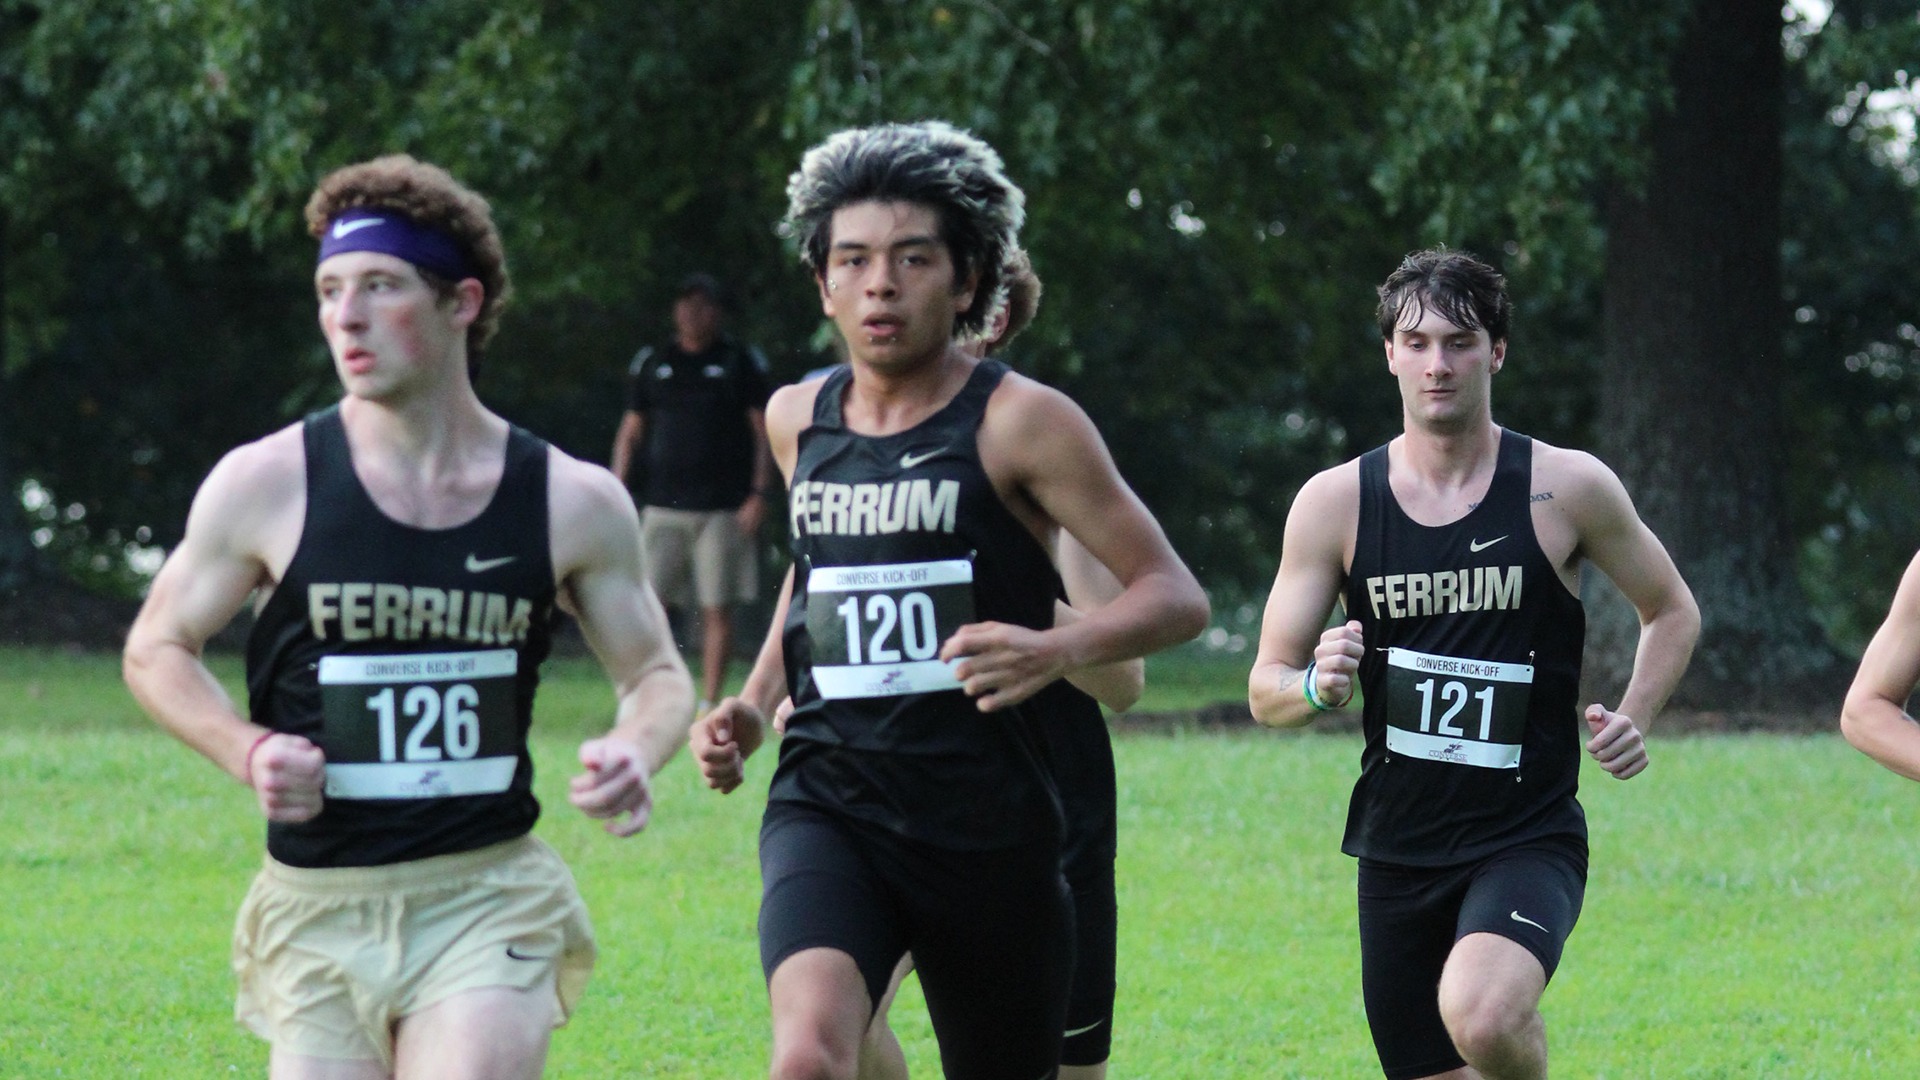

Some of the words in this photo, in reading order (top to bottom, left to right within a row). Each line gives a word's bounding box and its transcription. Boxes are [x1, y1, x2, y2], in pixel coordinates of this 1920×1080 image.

[791, 479, 960, 539] FERRUM
[836, 571, 881, 585] CONVERSE
[883, 568, 929, 583] KICK-OFF
[1366, 565, 1523, 619] FERRUM
[308, 583, 533, 644] FERRUM
[837, 592, 938, 665] 120
[366, 661, 421, 677] CONVERSE
[1416, 657, 1459, 673] CONVERSE
[1460, 661, 1500, 677] KICK-OFF
[366, 684, 480, 763] 126
[1415, 678, 1495, 740] 121
